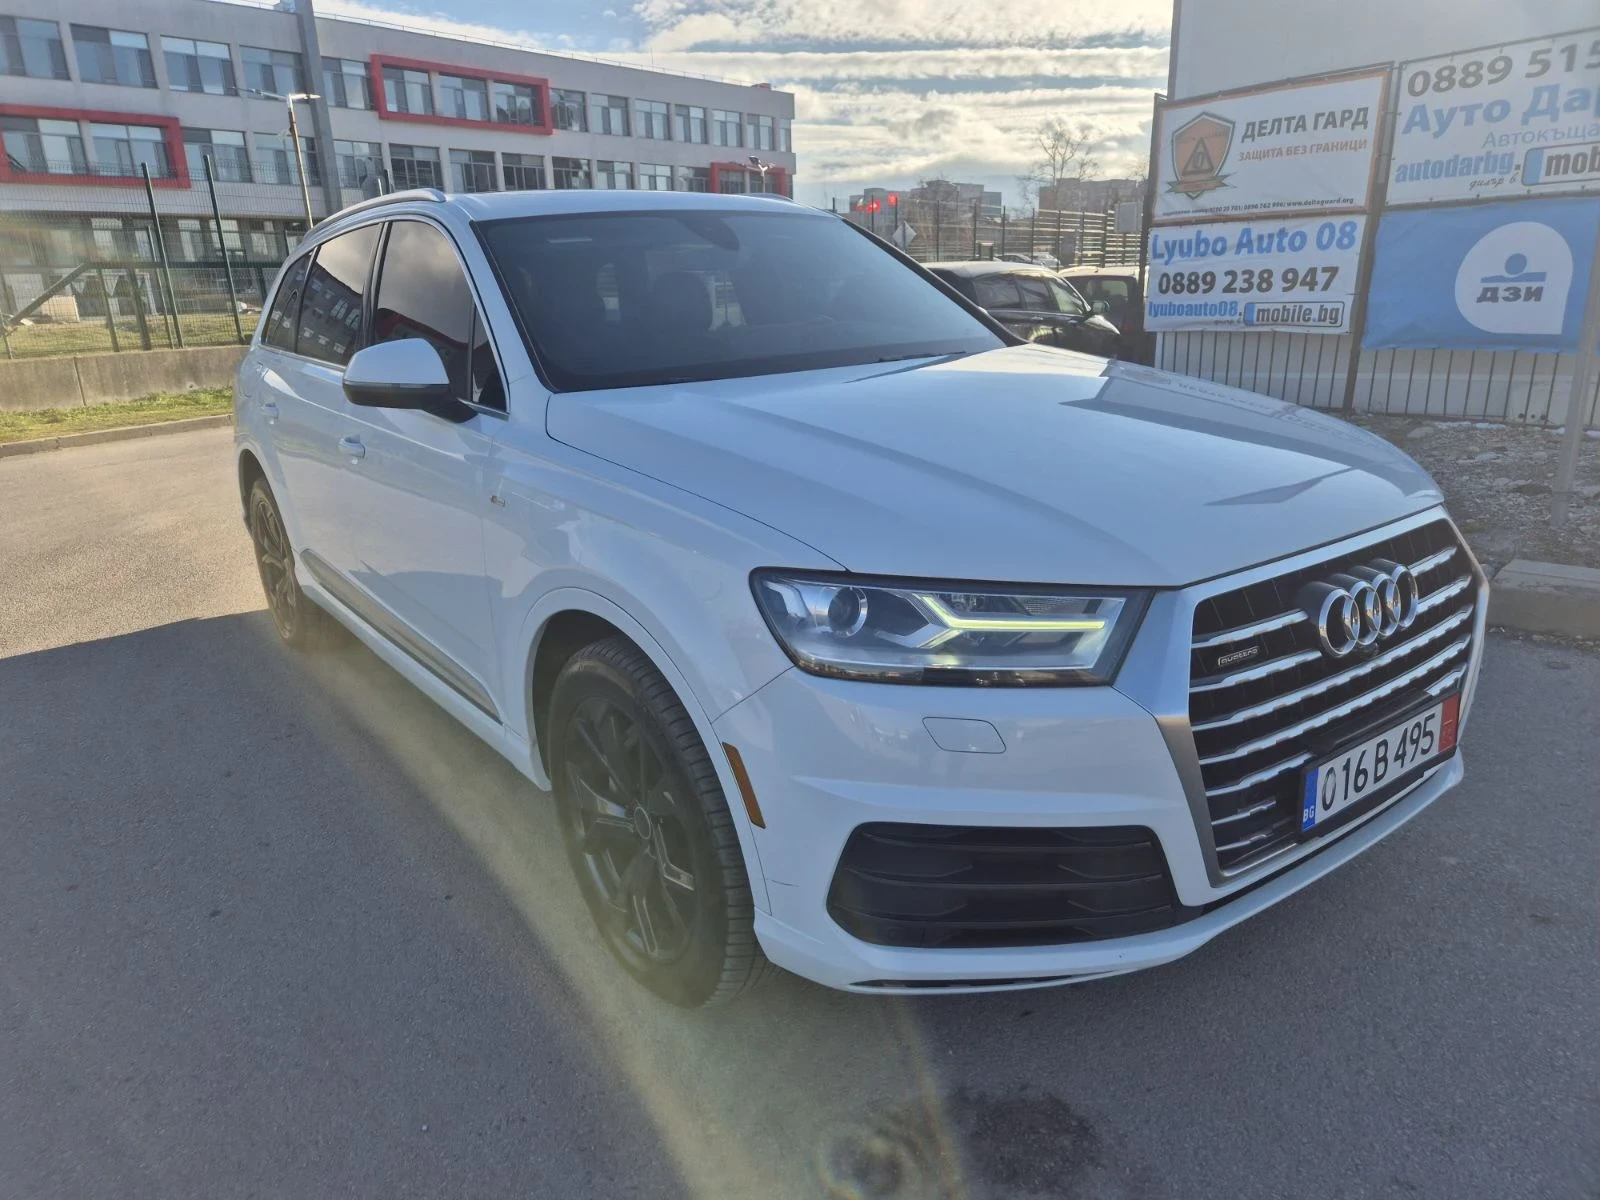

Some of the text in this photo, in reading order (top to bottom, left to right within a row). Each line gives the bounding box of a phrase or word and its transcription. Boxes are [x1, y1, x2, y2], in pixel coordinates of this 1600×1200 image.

[1407, 39, 1600, 97] 0889 515
[1401, 82, 1600, 140] Ауто Да
[1240, 106, 1370, 143] ДЕЛТА ГАРД
[1238, 138, 1368, 162] ЗАЩИТА БЕЗ ГРАНИЦИ
[1152, 220, 1358, 266] Lyubo Auto 08
[1158, 266, 1339, 295] 0889 238 947
[1476, 285, 1544, 304] ДЗИ
[1256, 303, 1340, 325] mobile.bg
[1221, 647, 1258, 665] quattro
[1302, 805, 1315, 822] BG
